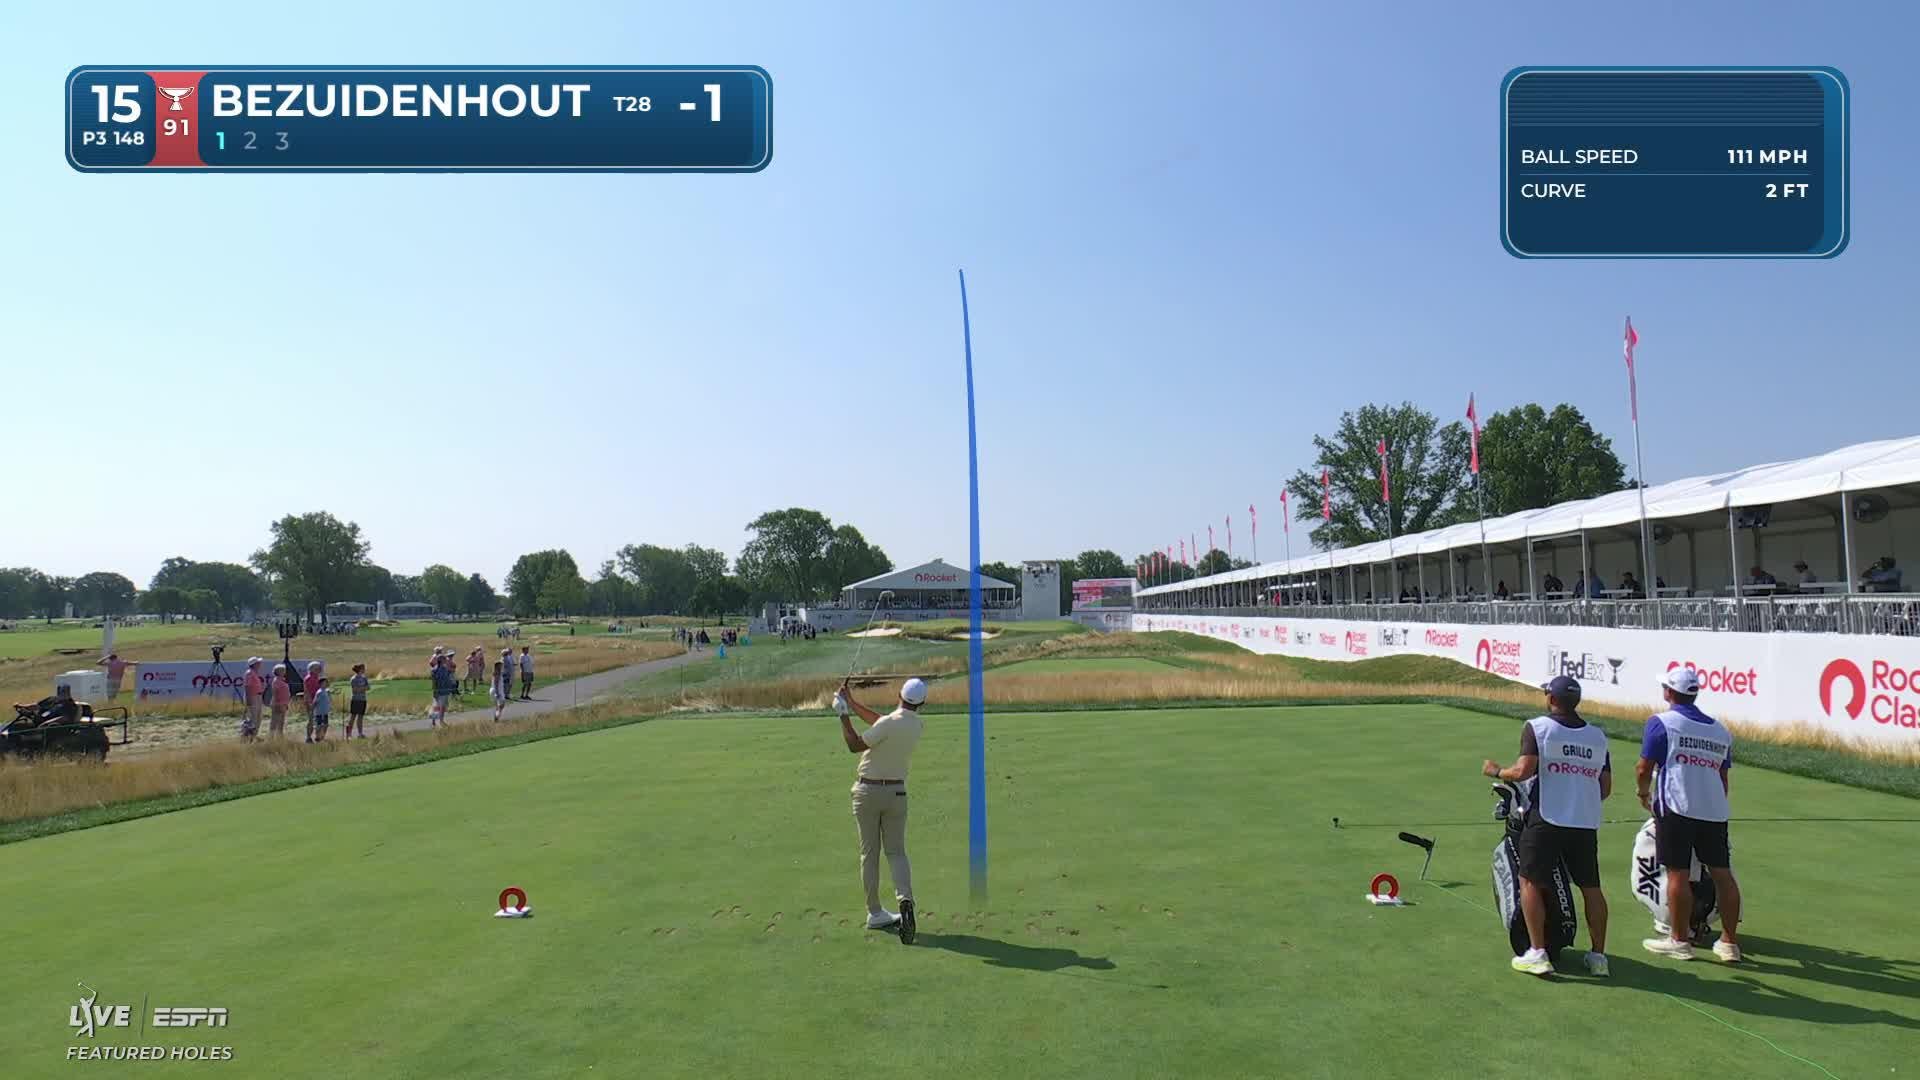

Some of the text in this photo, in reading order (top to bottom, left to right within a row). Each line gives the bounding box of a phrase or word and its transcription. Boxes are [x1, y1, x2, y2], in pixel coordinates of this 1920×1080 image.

[923, 573, 958, 583] Rocket
[1432, 630, 1458, 647] Rocket
[1492, 639, 1520, 657] Rocket
[1492, 657, 1520, 676] Classic
[1561, 651, 1605, 681] FedEx
[1871, 694, 1920, 728] Cla
[1562, 744, 1593, 759] GRILLO
[1561, 762, 1600, 778] Rocket
[1689, 755, 1720, 770] Rocke
[1637, 856, 1660, 906] PXG
[1552, 866, 1572, 918] TOPGOLF
